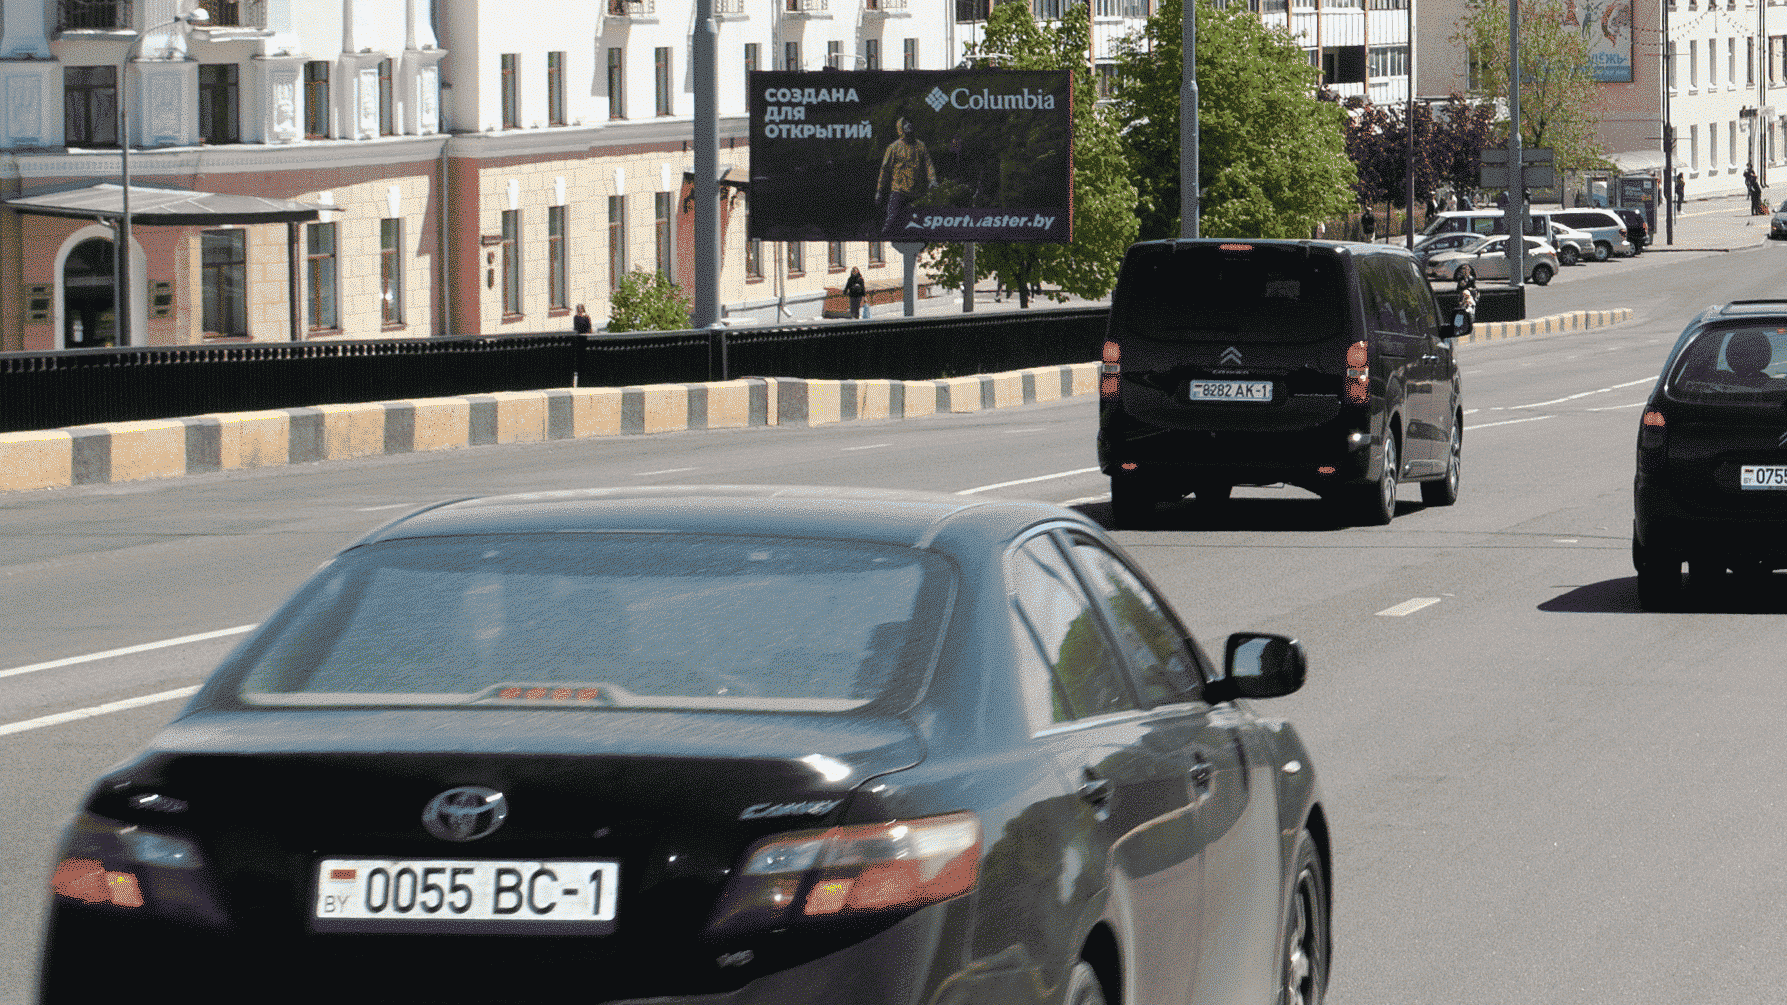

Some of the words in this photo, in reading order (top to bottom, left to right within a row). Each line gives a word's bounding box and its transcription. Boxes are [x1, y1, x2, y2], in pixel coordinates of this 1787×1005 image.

[764, 87, 860, 105] СОЗДАНА
[950, 87, 1056, 110] Columbia
[764, 106, 806, 123] ДЛЯ
[764, 119, 873, 139] ОТКРЫТИЙ
[1203, 383, 1233, 397] 8282
[364, 867, 475, 914] 0055
[491, 867, 603, 916] BC-1
[323, 894, 350, 913] BY
